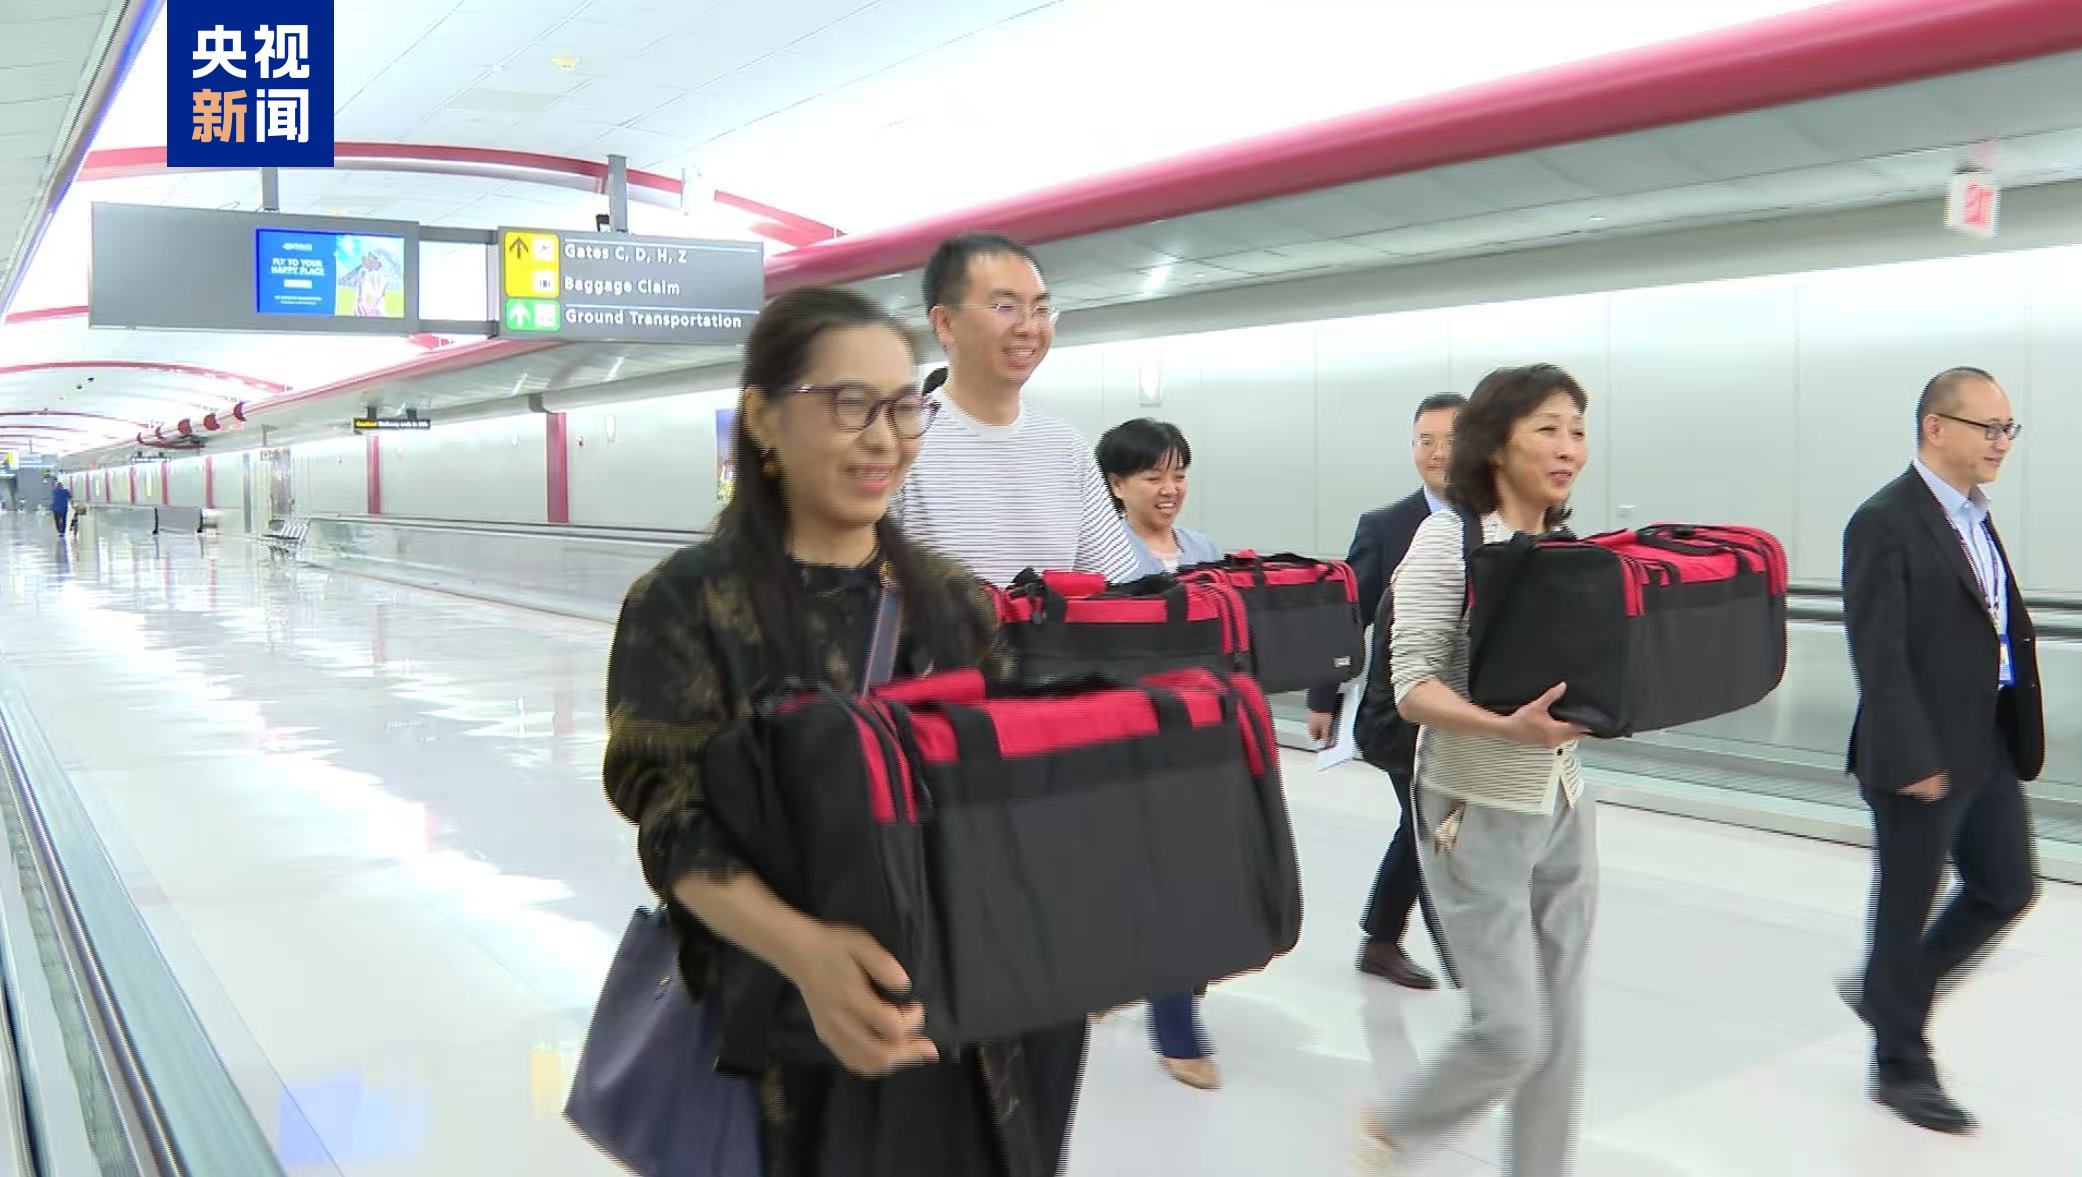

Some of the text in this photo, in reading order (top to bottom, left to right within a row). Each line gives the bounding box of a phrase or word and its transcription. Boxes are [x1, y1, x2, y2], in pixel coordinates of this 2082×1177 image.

[287, 258, 299, 267] TO
[564, 244, 687, 264] Gates C, D, H, Z
[564, 275, 680, 295] Baggage Claim
[565, 309, 742, 328] Ground Transportation
